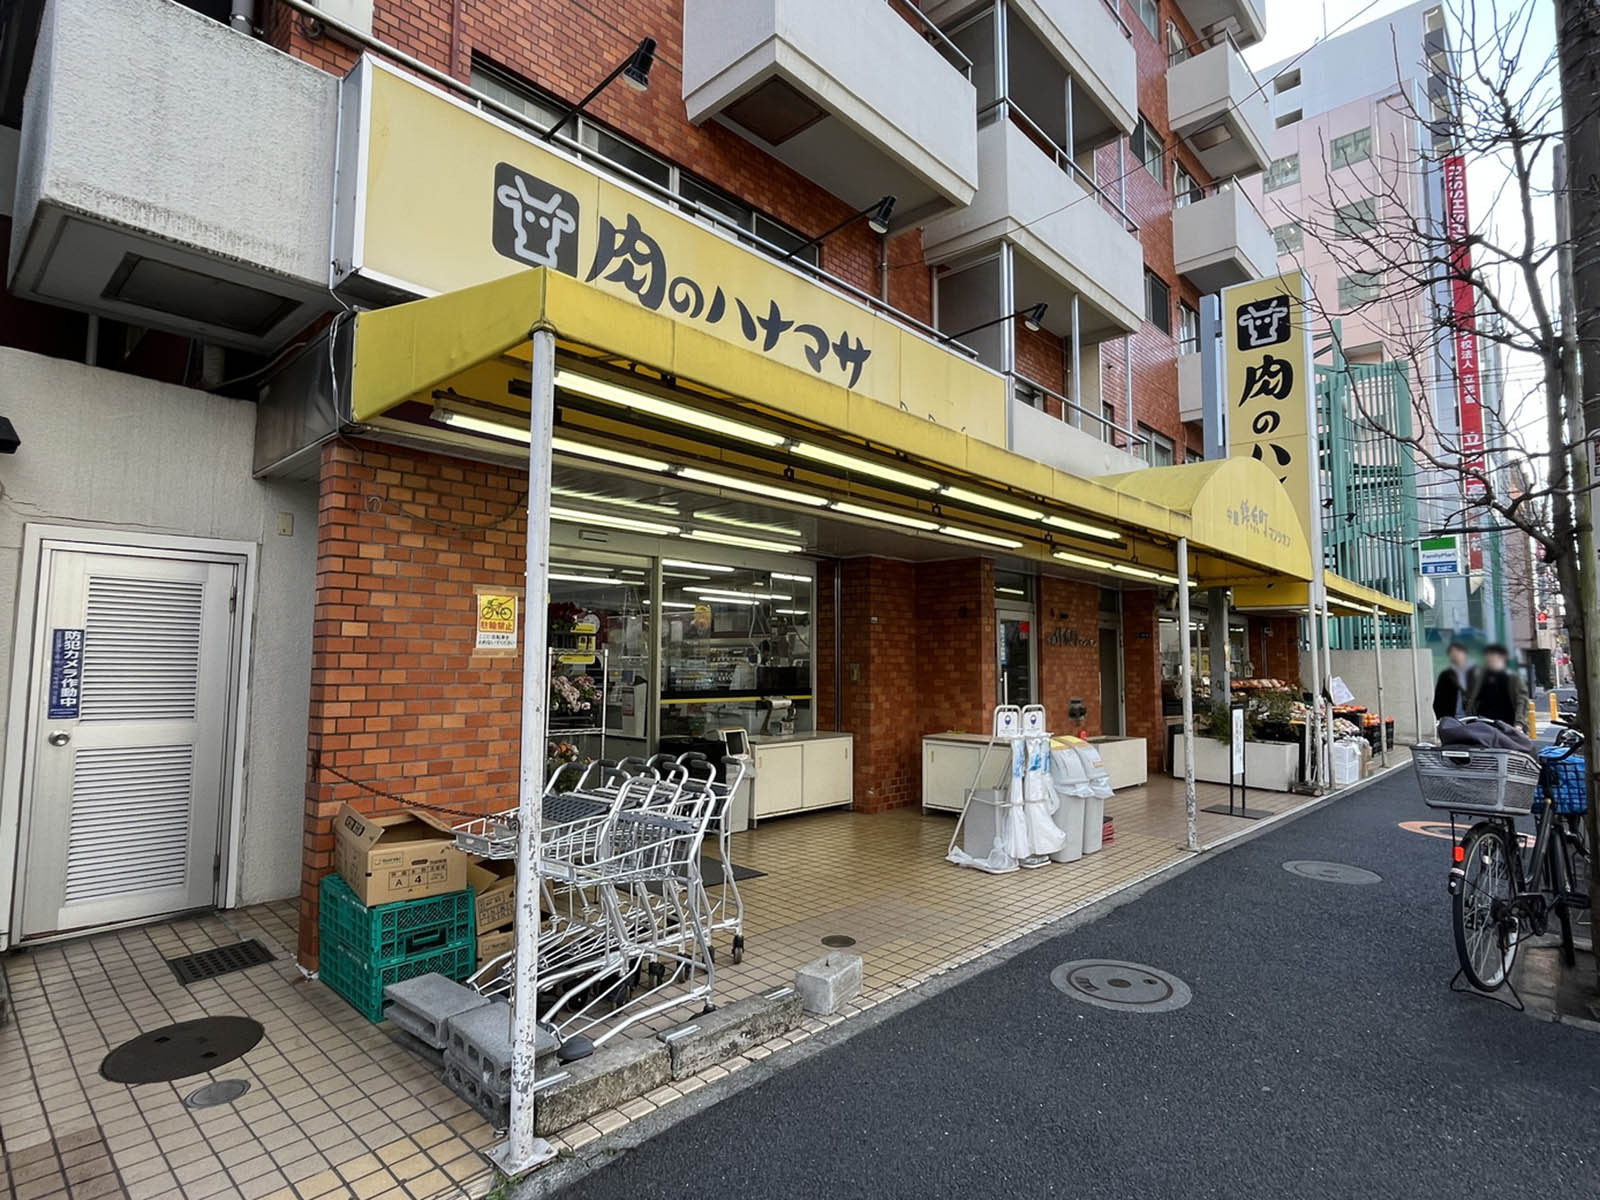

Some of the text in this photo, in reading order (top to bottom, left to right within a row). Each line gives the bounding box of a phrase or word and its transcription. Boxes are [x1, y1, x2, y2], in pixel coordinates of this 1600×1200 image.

[586, 213, 871, 388] 肉のハナマサ
[1238, 355, 1293, 484] 肉のハ
[61, 631, 81, 707] 防犯カメラ作動中
